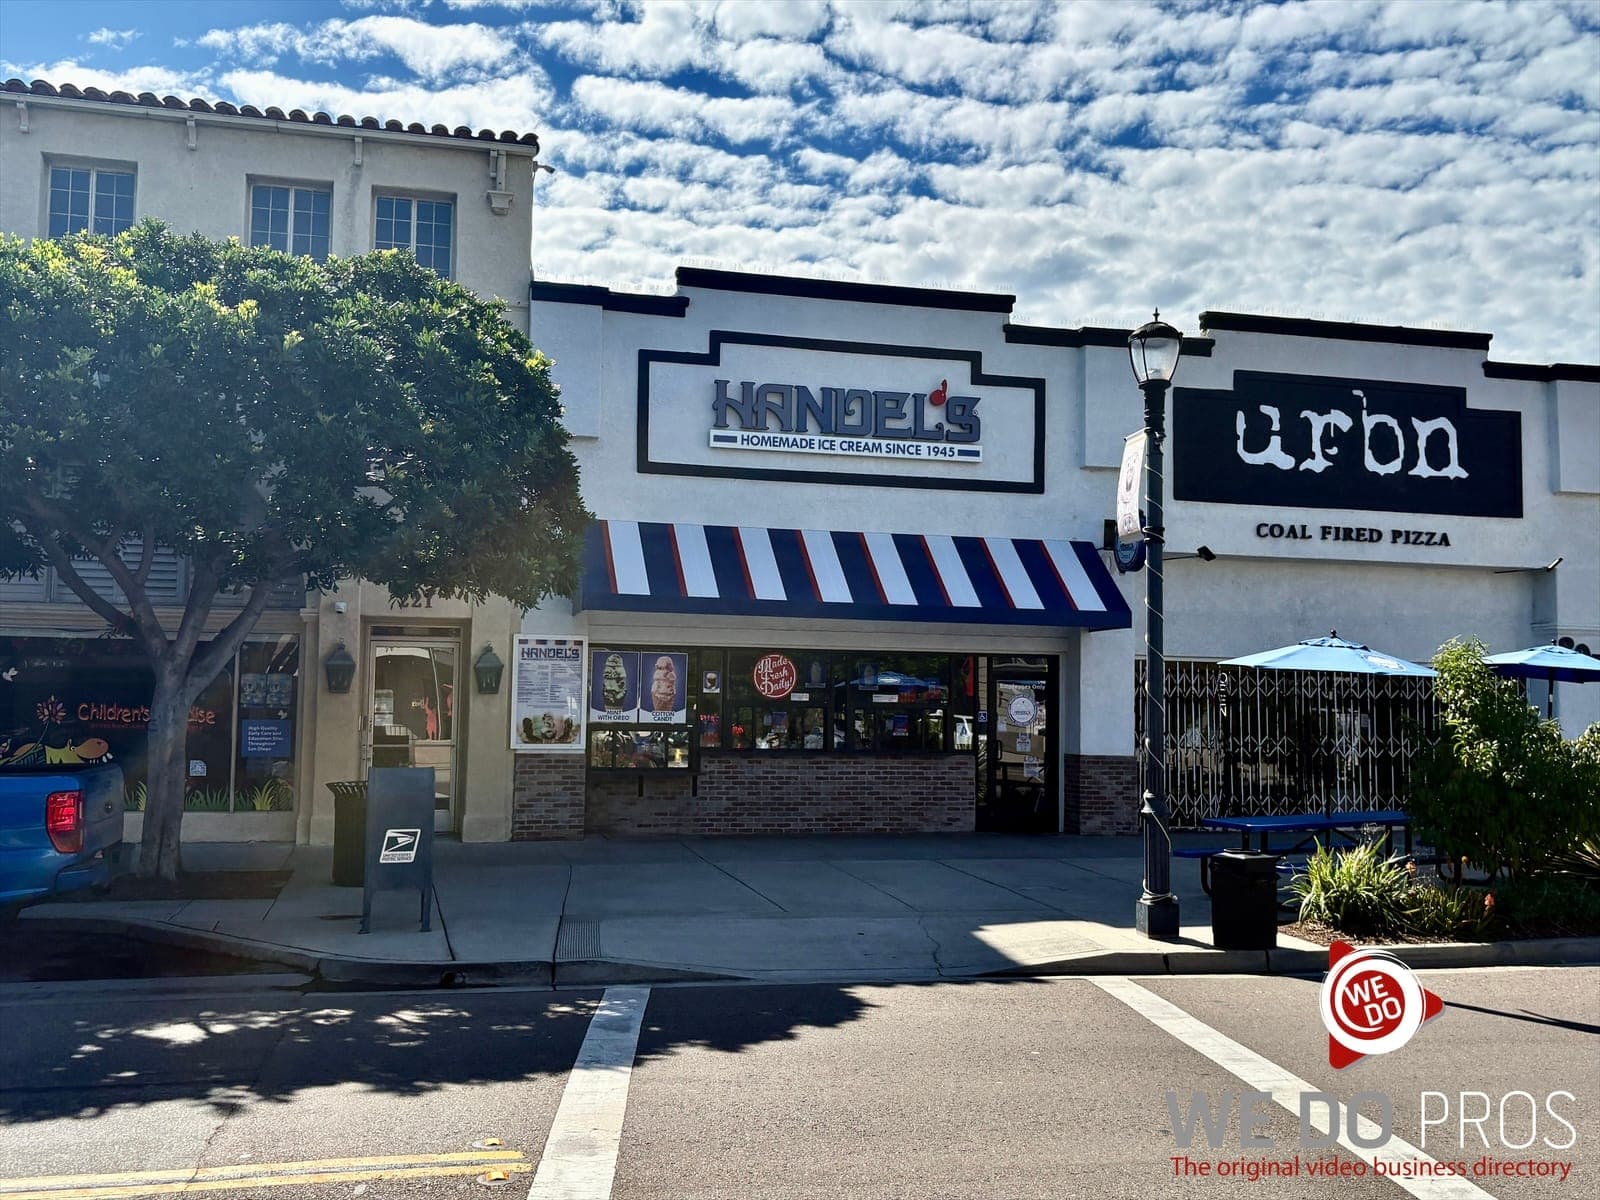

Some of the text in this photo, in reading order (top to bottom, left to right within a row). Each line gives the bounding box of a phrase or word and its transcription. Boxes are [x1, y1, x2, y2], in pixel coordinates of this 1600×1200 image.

[712, 379, 981, 442] HANDEL'S
[1236, 390, 1469, 479] urbn
[741, 434, 955, 457] HOMEMADE ICE CREAM SINCE 1945
[1256, 523, 1451, 547] COAL FIRED PIZZA
[758, 655, 788, 673] Made
[760, 666, 788, 684] Fresh
[760, 676, 793, 695] Daily!
[78, 703, 151, 723] Children's
